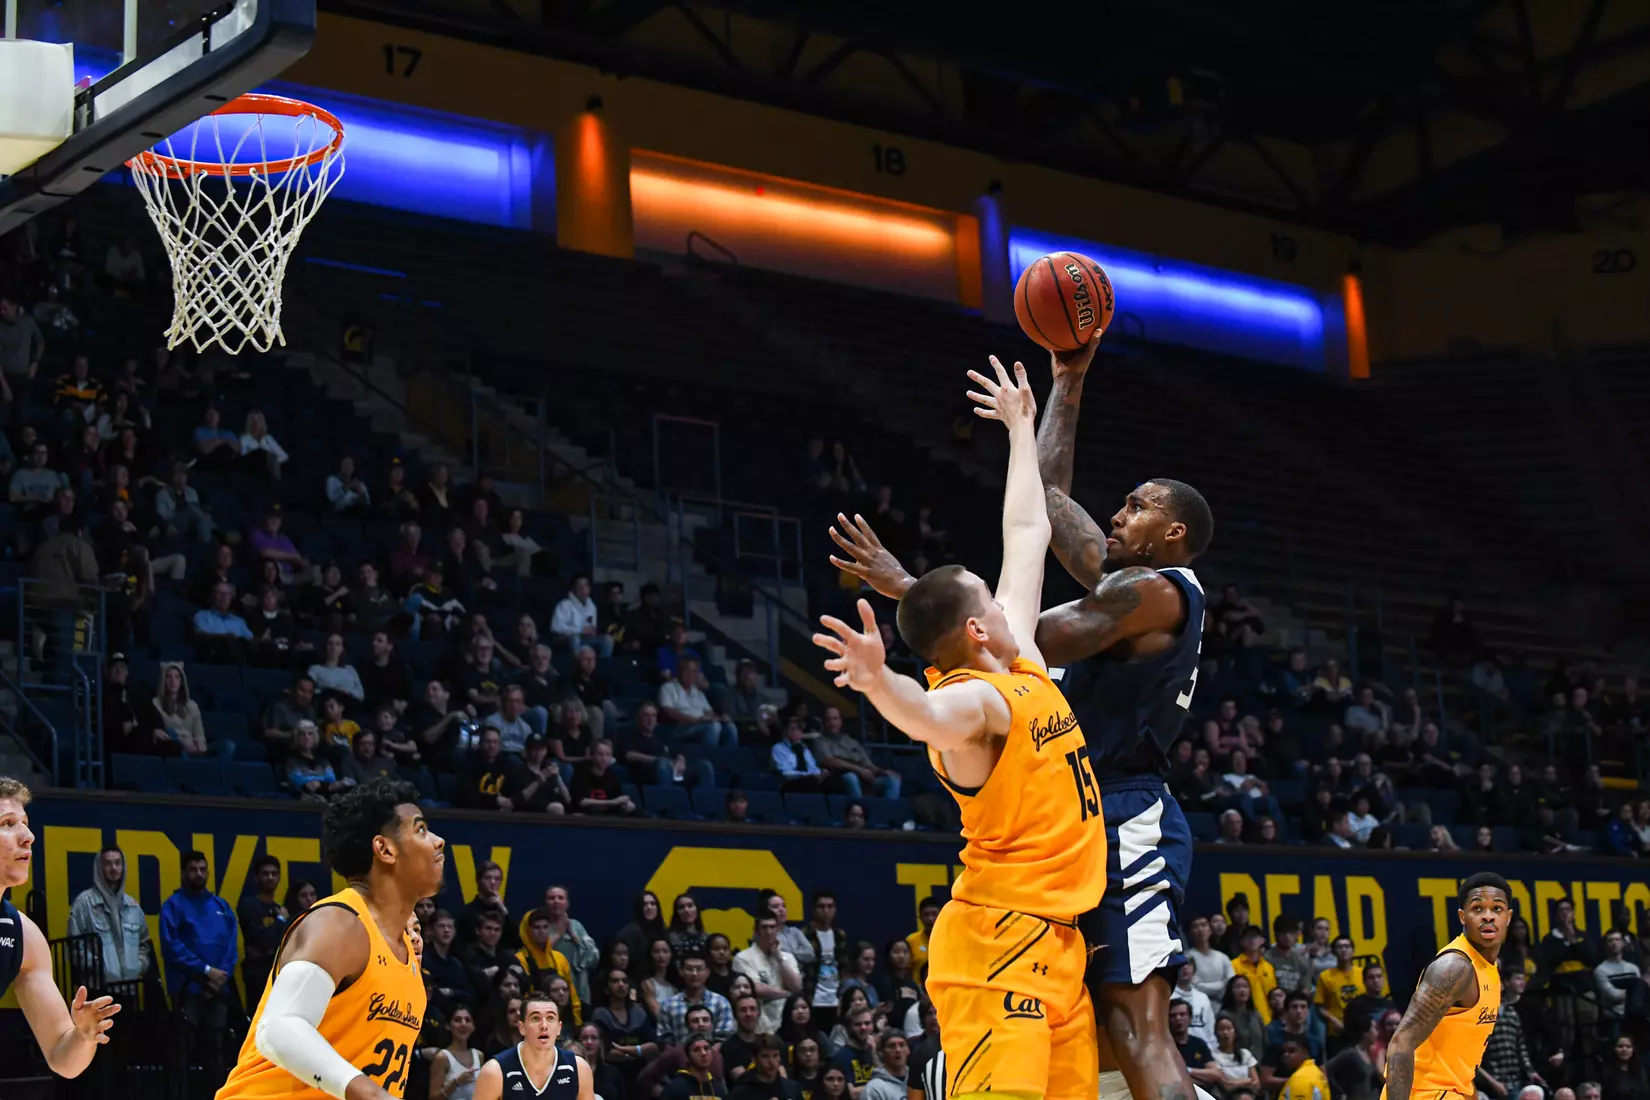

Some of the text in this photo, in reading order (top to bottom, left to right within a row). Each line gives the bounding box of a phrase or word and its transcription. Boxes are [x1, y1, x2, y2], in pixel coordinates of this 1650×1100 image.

[382, 43, 422, 78] 17
[873, 144, 906, 175] 18
[1593, 248, 1636, 273] 20
[1064, 263, 1095, 330] Wilson
[1092, 265, 1112, 311] NCAA
[1065, 745, 1100, 822] 15
